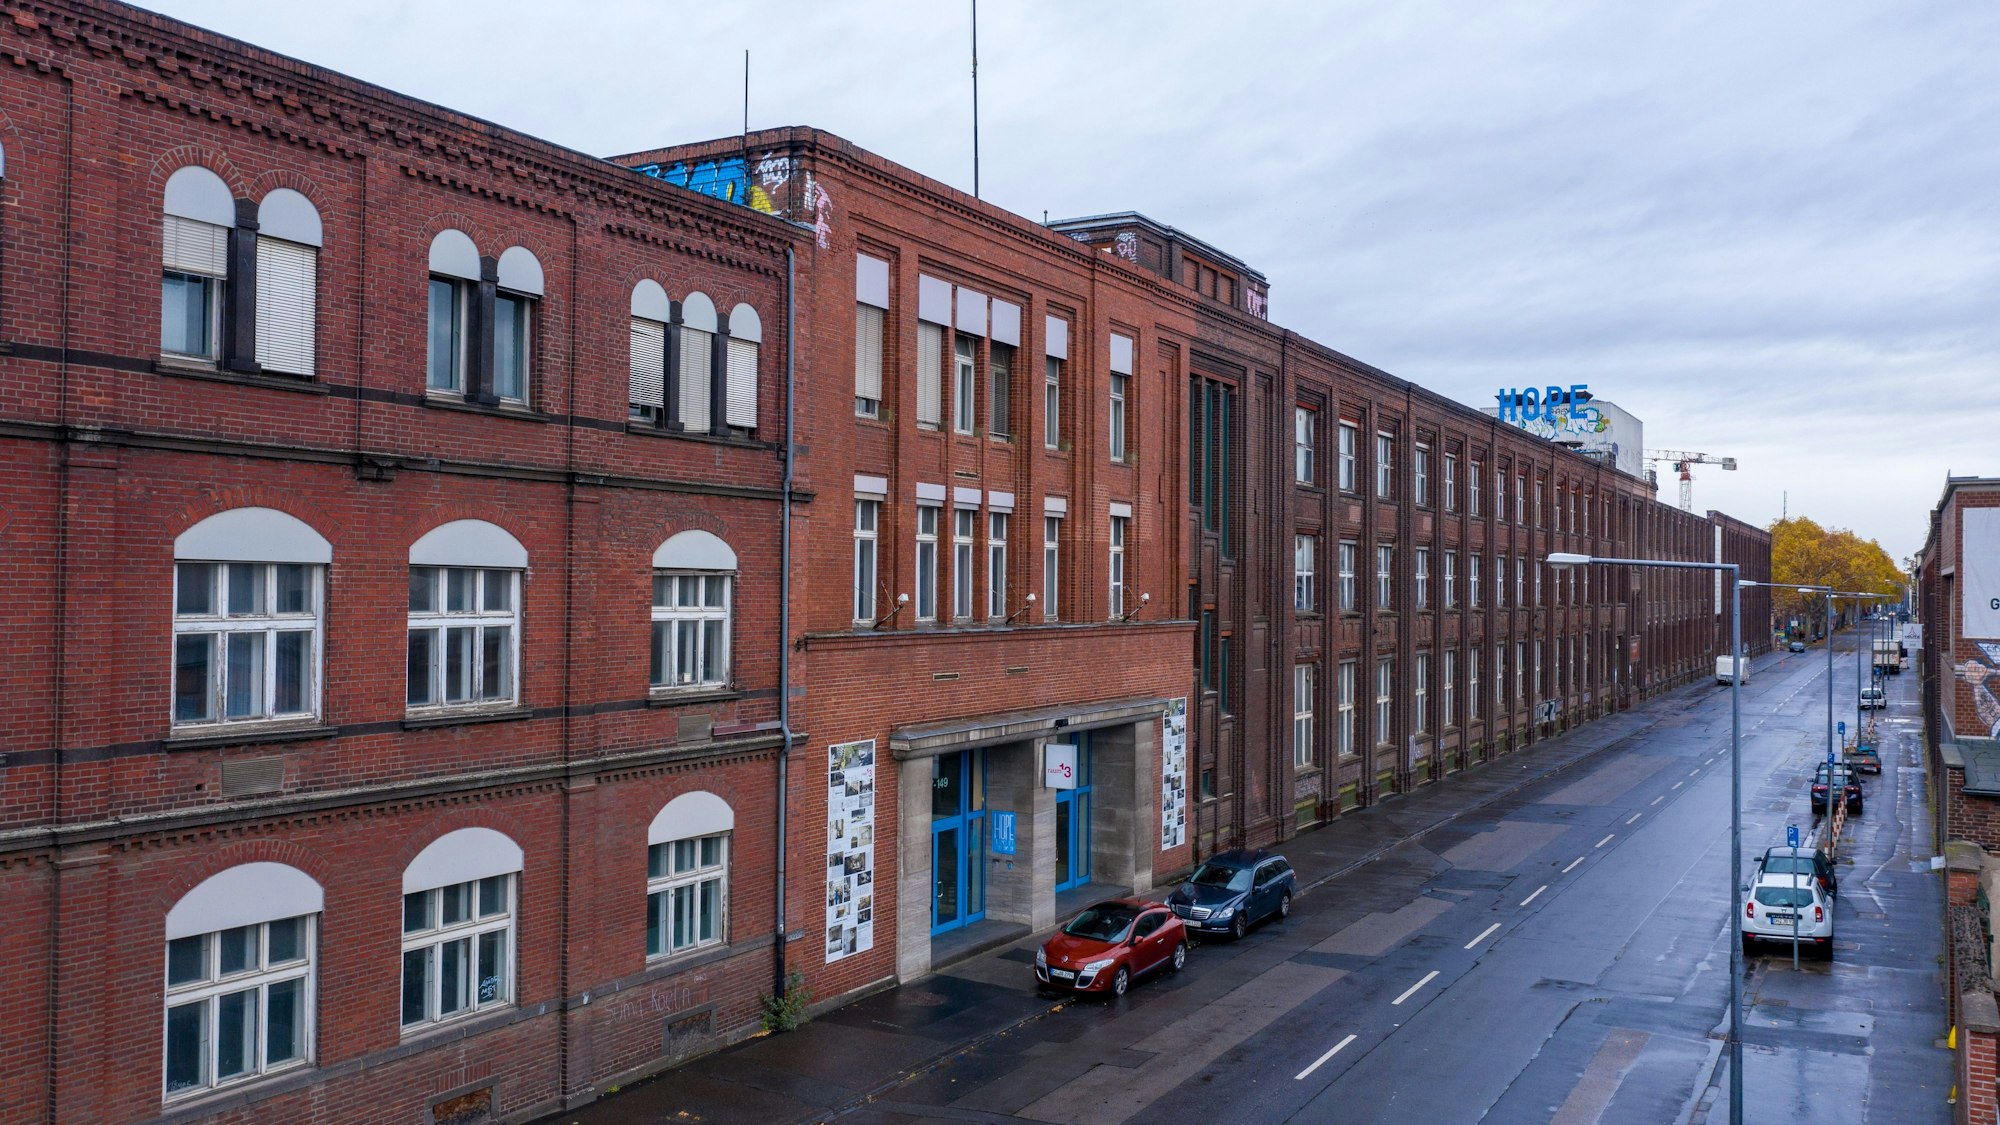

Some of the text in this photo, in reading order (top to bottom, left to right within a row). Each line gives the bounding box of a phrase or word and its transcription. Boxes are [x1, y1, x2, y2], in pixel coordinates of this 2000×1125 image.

[1499, 385, 1587, 421] HOPE
[932, 777, 949, 789] -149
[994, 812, 1014, 840] HOPE
